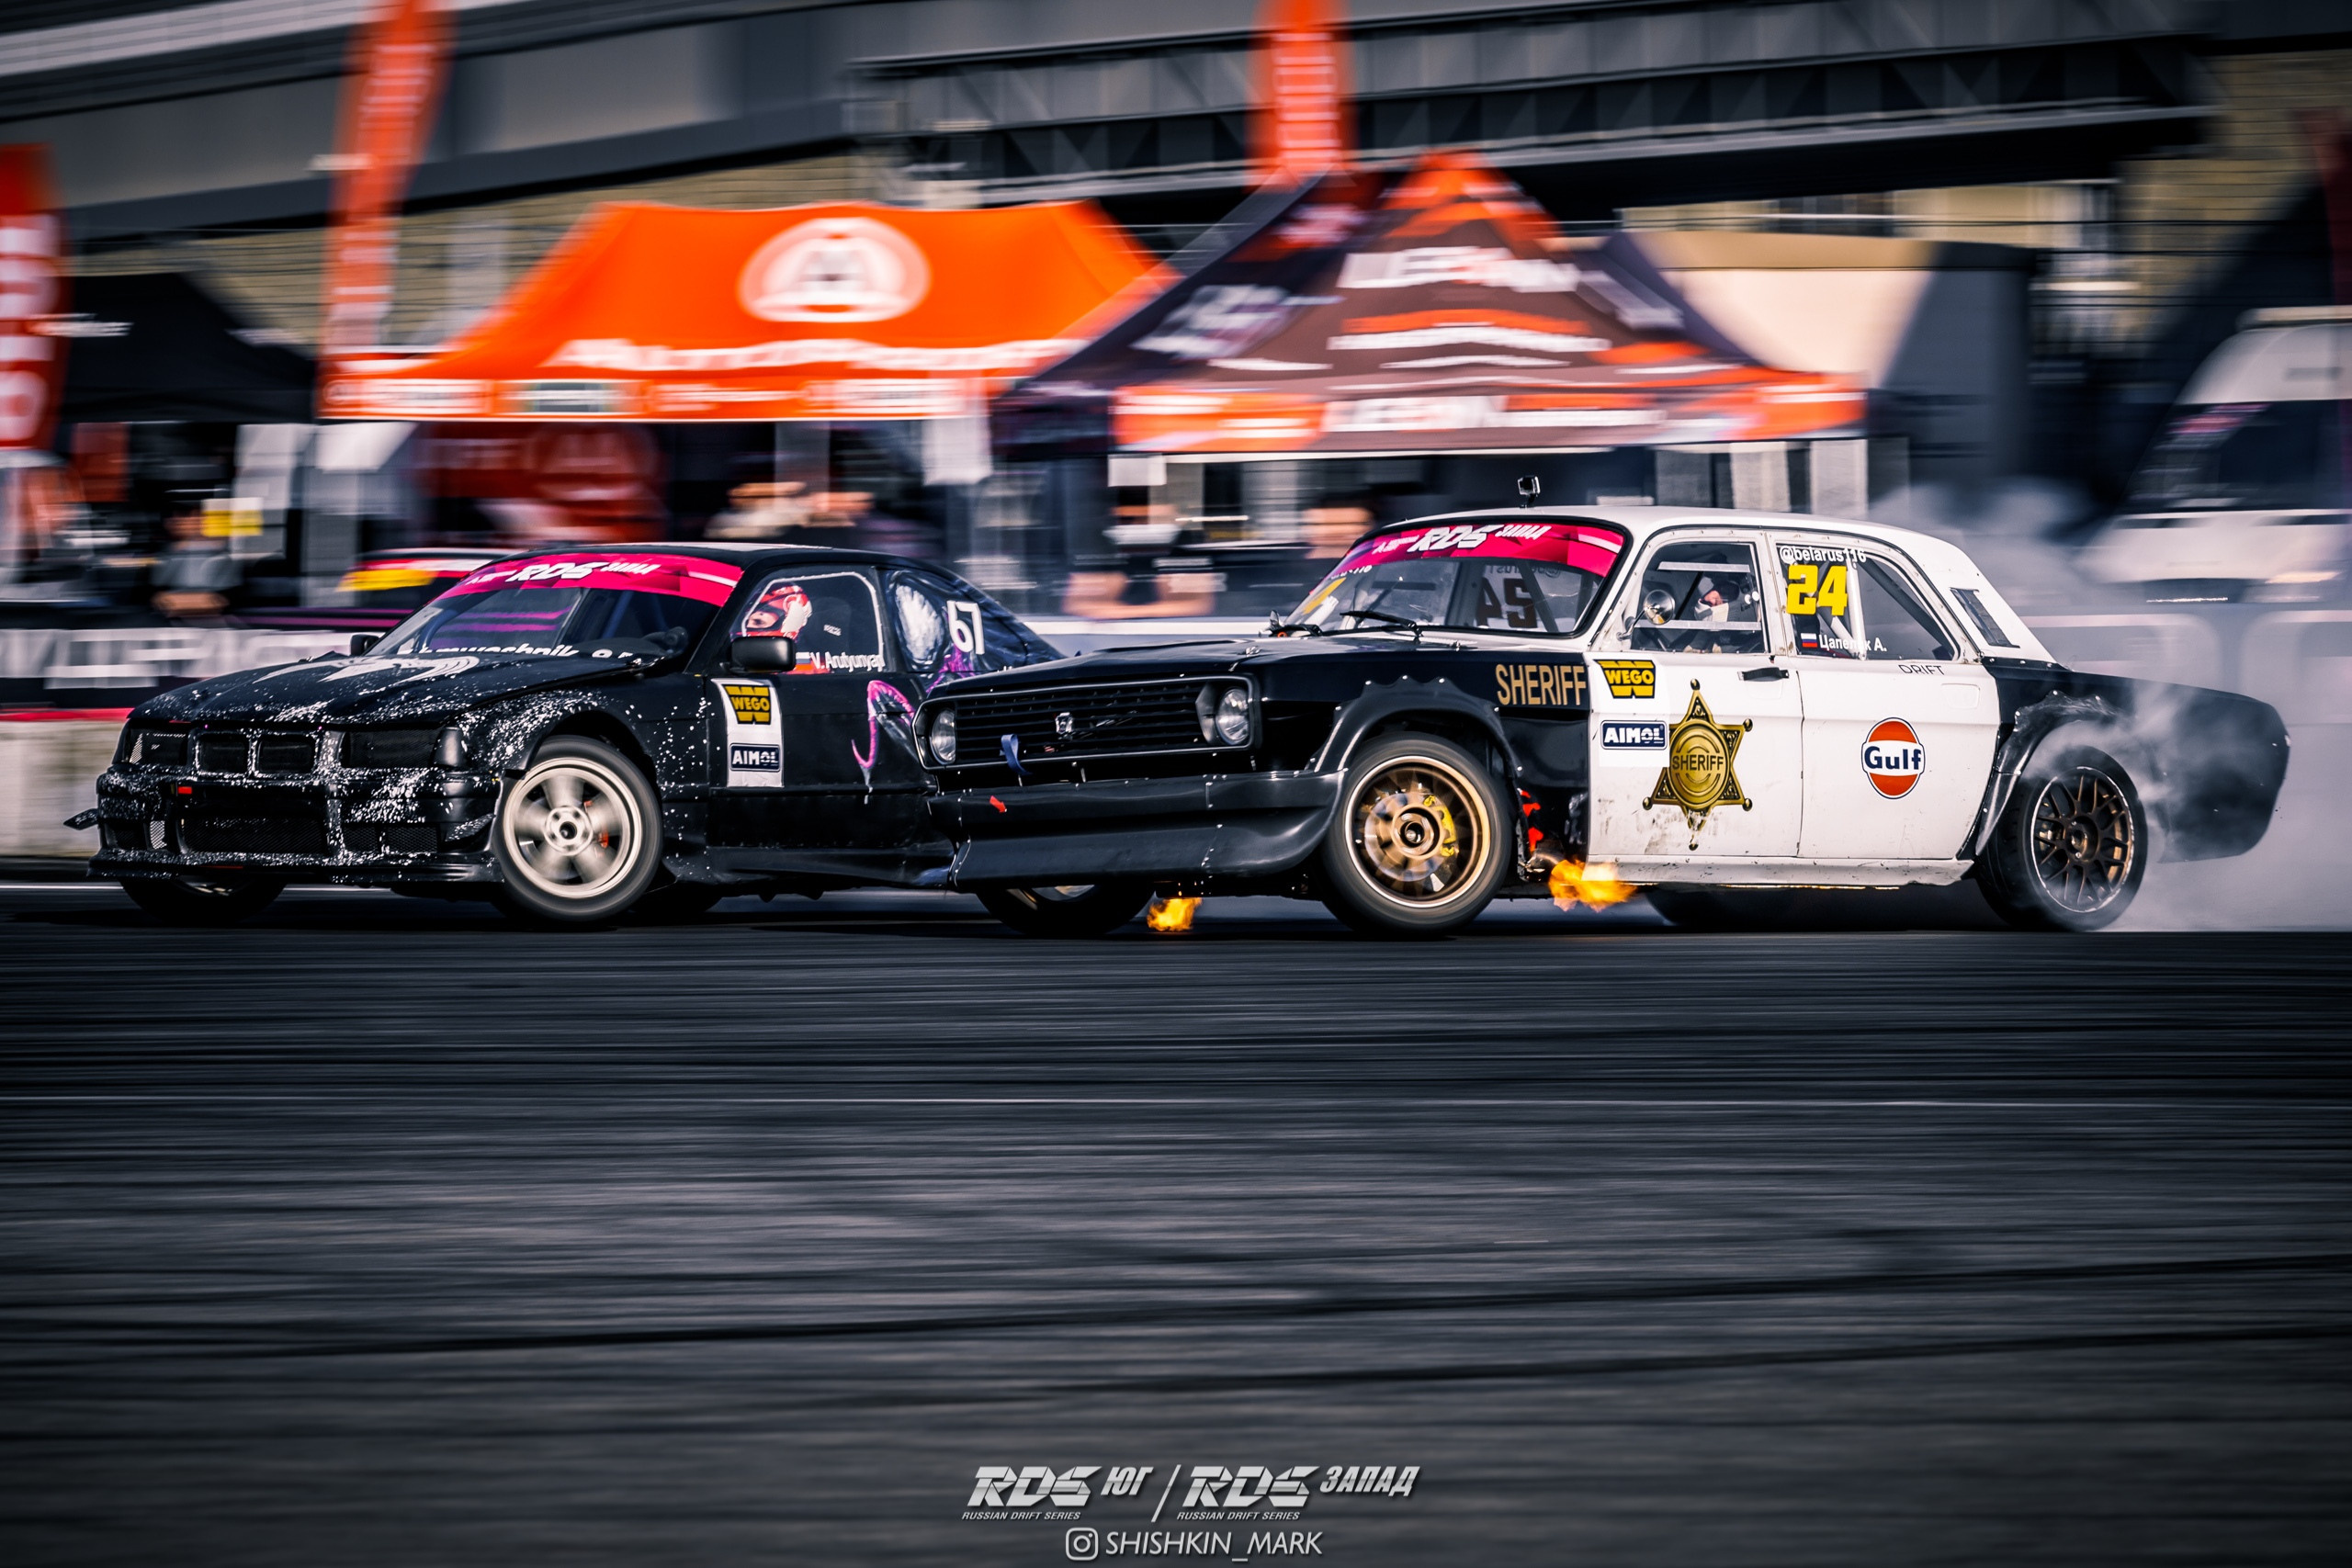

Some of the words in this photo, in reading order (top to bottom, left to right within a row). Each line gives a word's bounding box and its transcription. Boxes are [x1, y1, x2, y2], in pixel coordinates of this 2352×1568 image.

[1408, 525, 1504, 553] RDS
[1780, 546, 1867, 565] @belarus116
[504, 562, 610, 582] RDS
[1786, 564, 1849, 616] 24
[946, 600, 985, 655] 67
[1819, 634, 1871, 651] Цапелк
[810, 651, 825, 670] V.
[1898, 664, 1945, 676] DRIFT
[1495, 663, 1587, 705] SHERIFF
[1604, 669, 1655, 685] WEGO
[729, 696, 771, 711] WEGO
[1604, 727, 1664, 744] AIMOL
[732, 750, 779, 766] AIMOL
[1671, 754, 1724, 772] SHERIFF
[1864, 745, 1922, 770] Gulf
